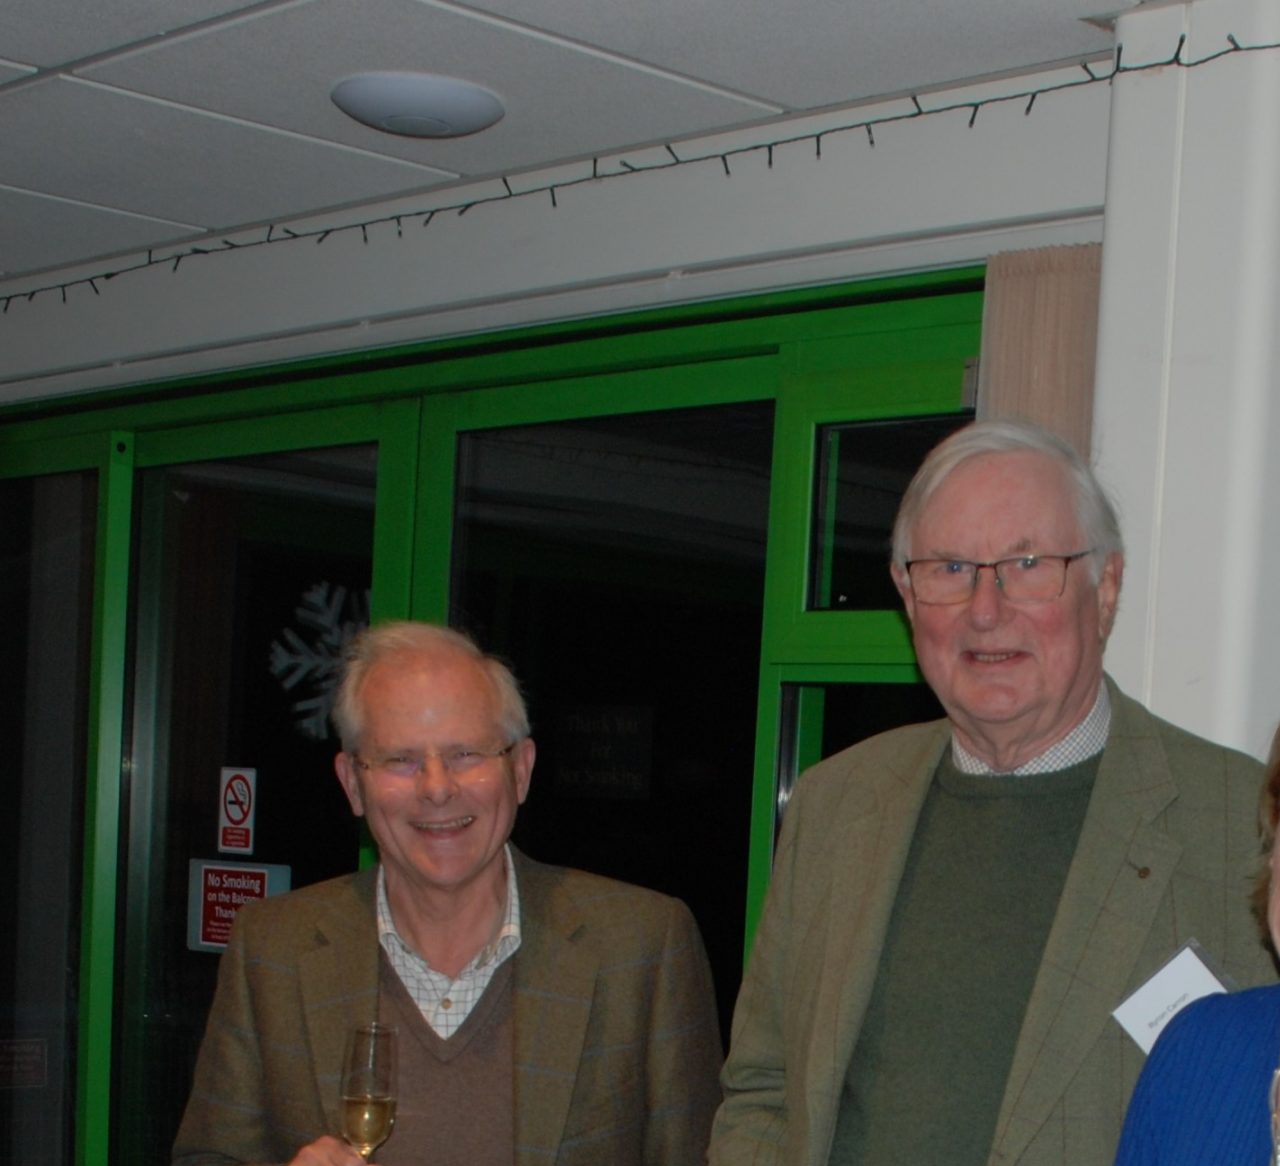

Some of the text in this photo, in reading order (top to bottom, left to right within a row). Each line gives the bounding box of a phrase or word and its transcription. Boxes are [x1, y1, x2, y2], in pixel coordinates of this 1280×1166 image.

[208, 873, 261, 894] No Smoking
[207, 892, 217, 902] on
[218, 892, 231, 903] the
